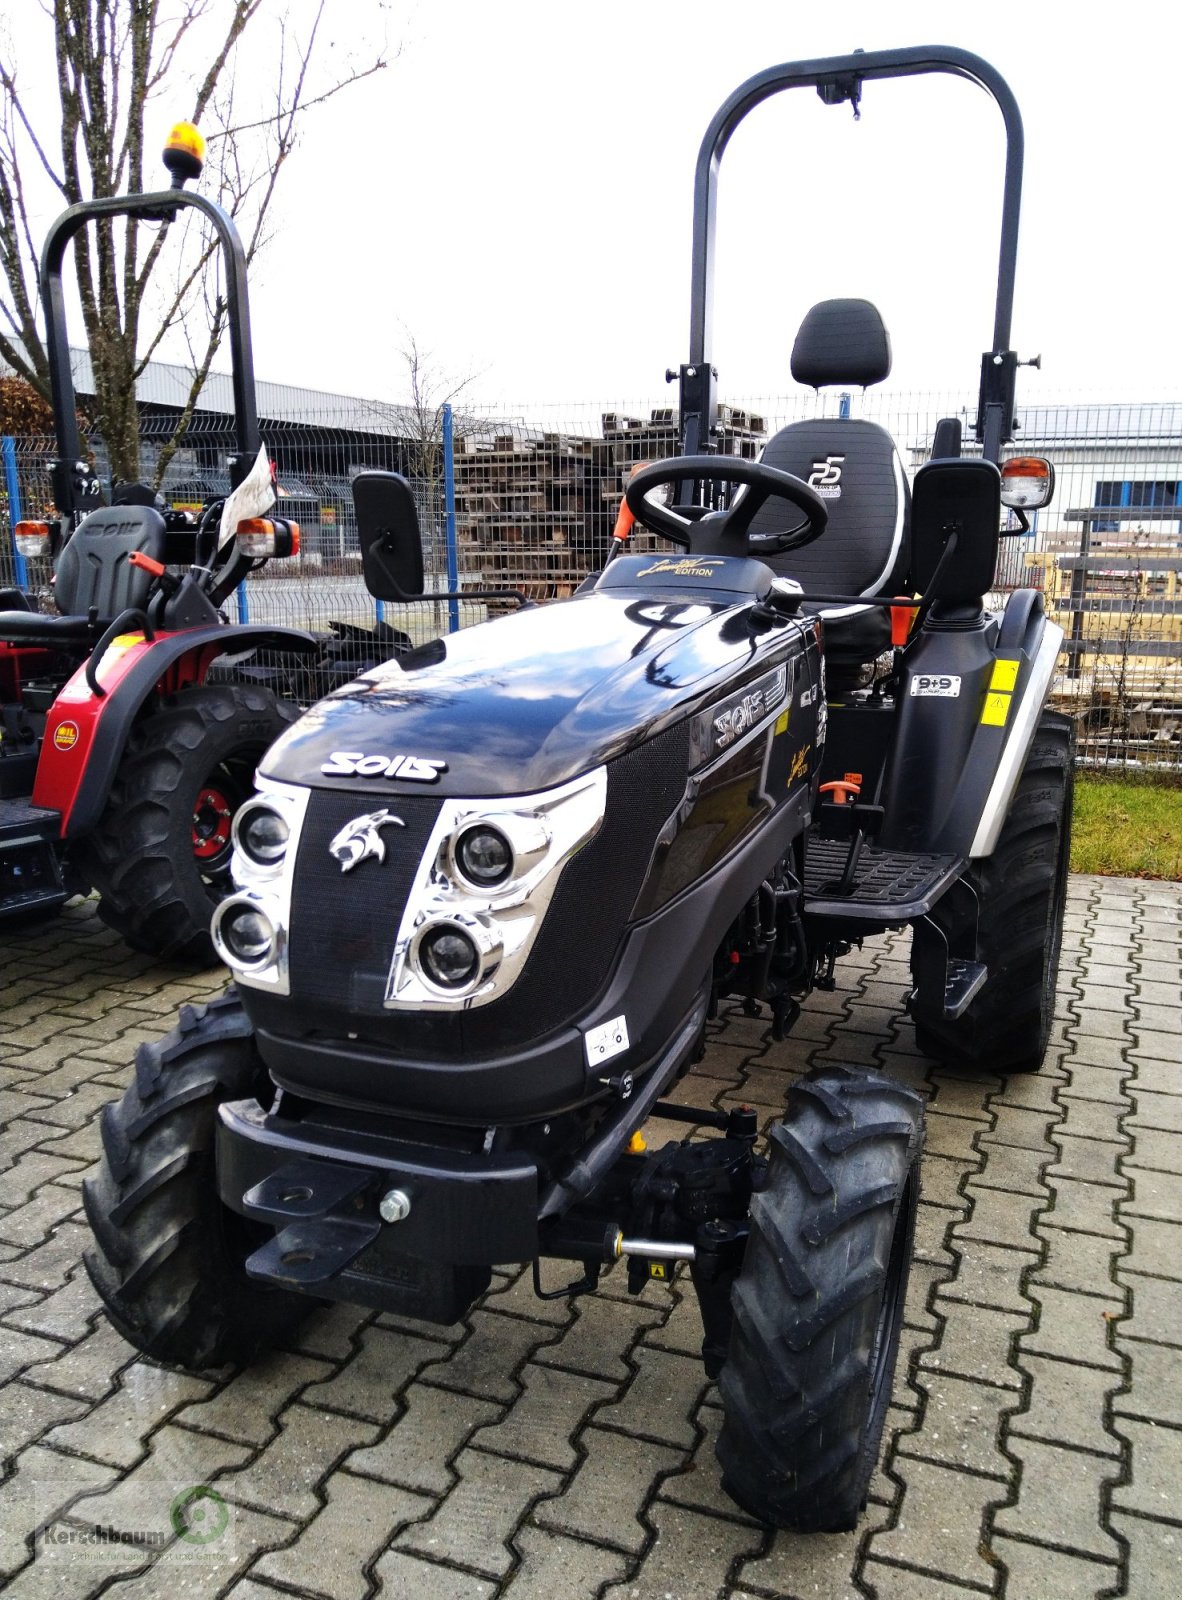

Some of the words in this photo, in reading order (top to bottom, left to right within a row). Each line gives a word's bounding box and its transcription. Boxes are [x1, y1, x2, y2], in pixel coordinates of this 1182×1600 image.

[808, 456, 845, 486] 25
[675, 567, 713, 576] EDITION
[919, 677, 952, 690] 9+9
